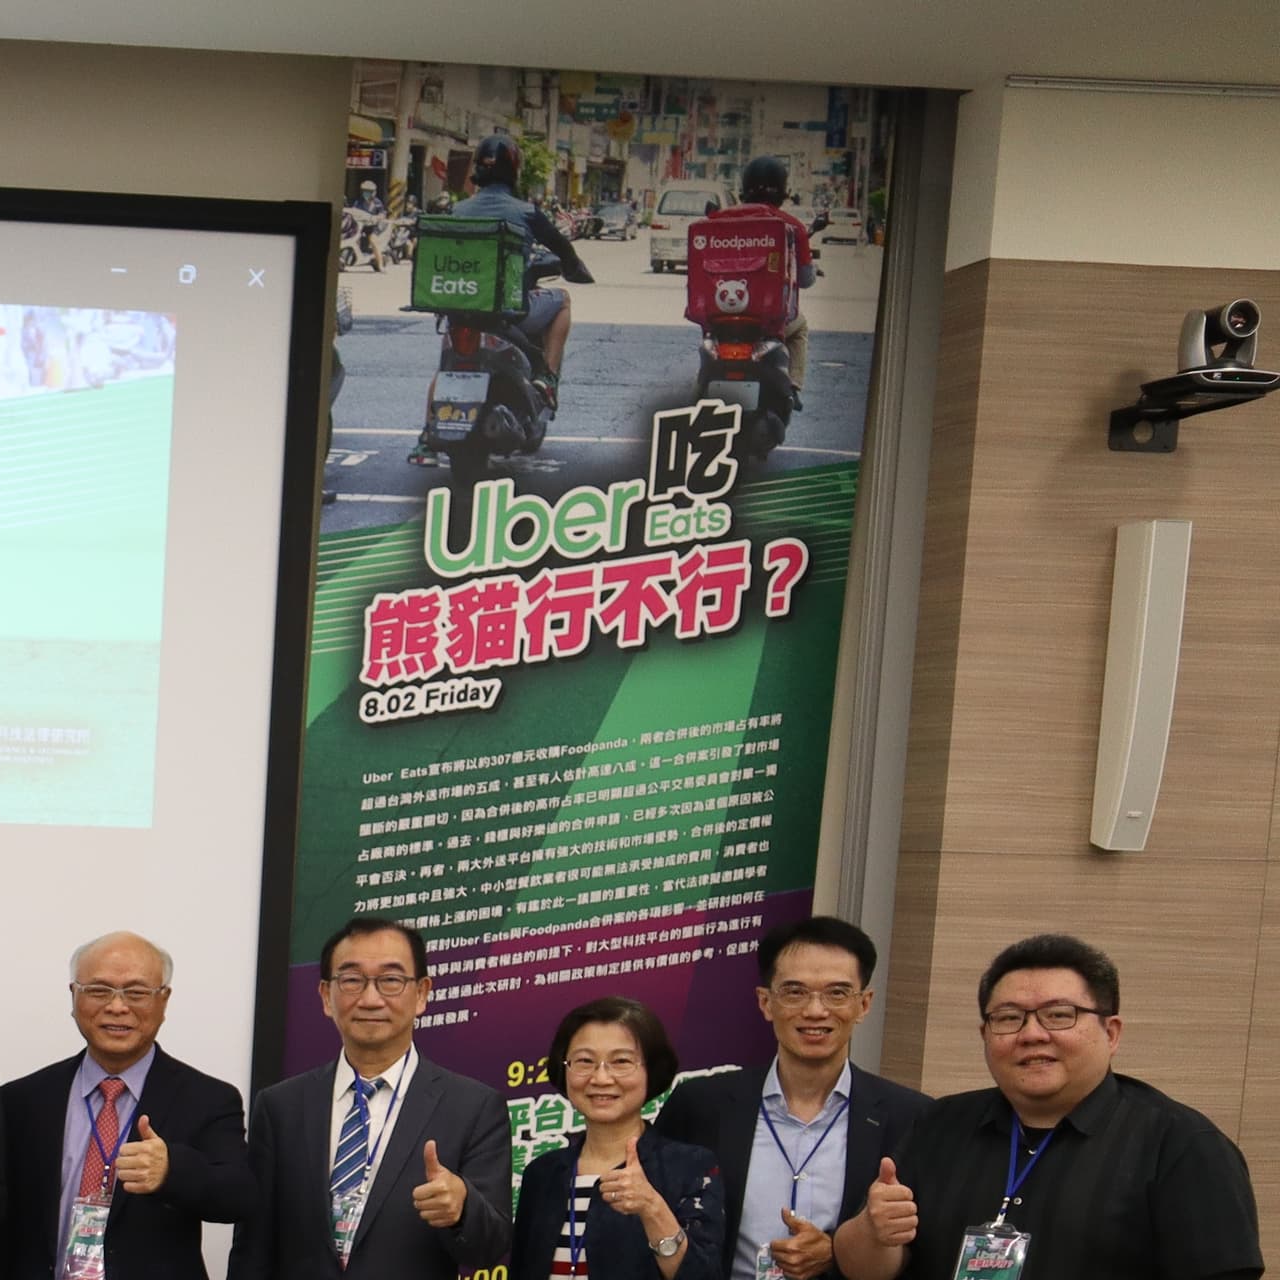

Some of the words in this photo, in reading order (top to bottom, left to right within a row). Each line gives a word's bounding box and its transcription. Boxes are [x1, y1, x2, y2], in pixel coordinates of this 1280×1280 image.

[709, 234, 777, 251] foodpanda
[433, 256, 480, 274] Uber
[431, 276, 478, 296] Eats
[653, 403, 742, 499] 吃
[426, 482, 643, 575] Uber
[649, 504, 729, 546] Eats
[360, 541, 809, 684] 熊貓行不行？
[363, 691, 417, 719] 8.02
[424, 682, 496, 712] Friday
[362, 770, 393, 785] Uber
